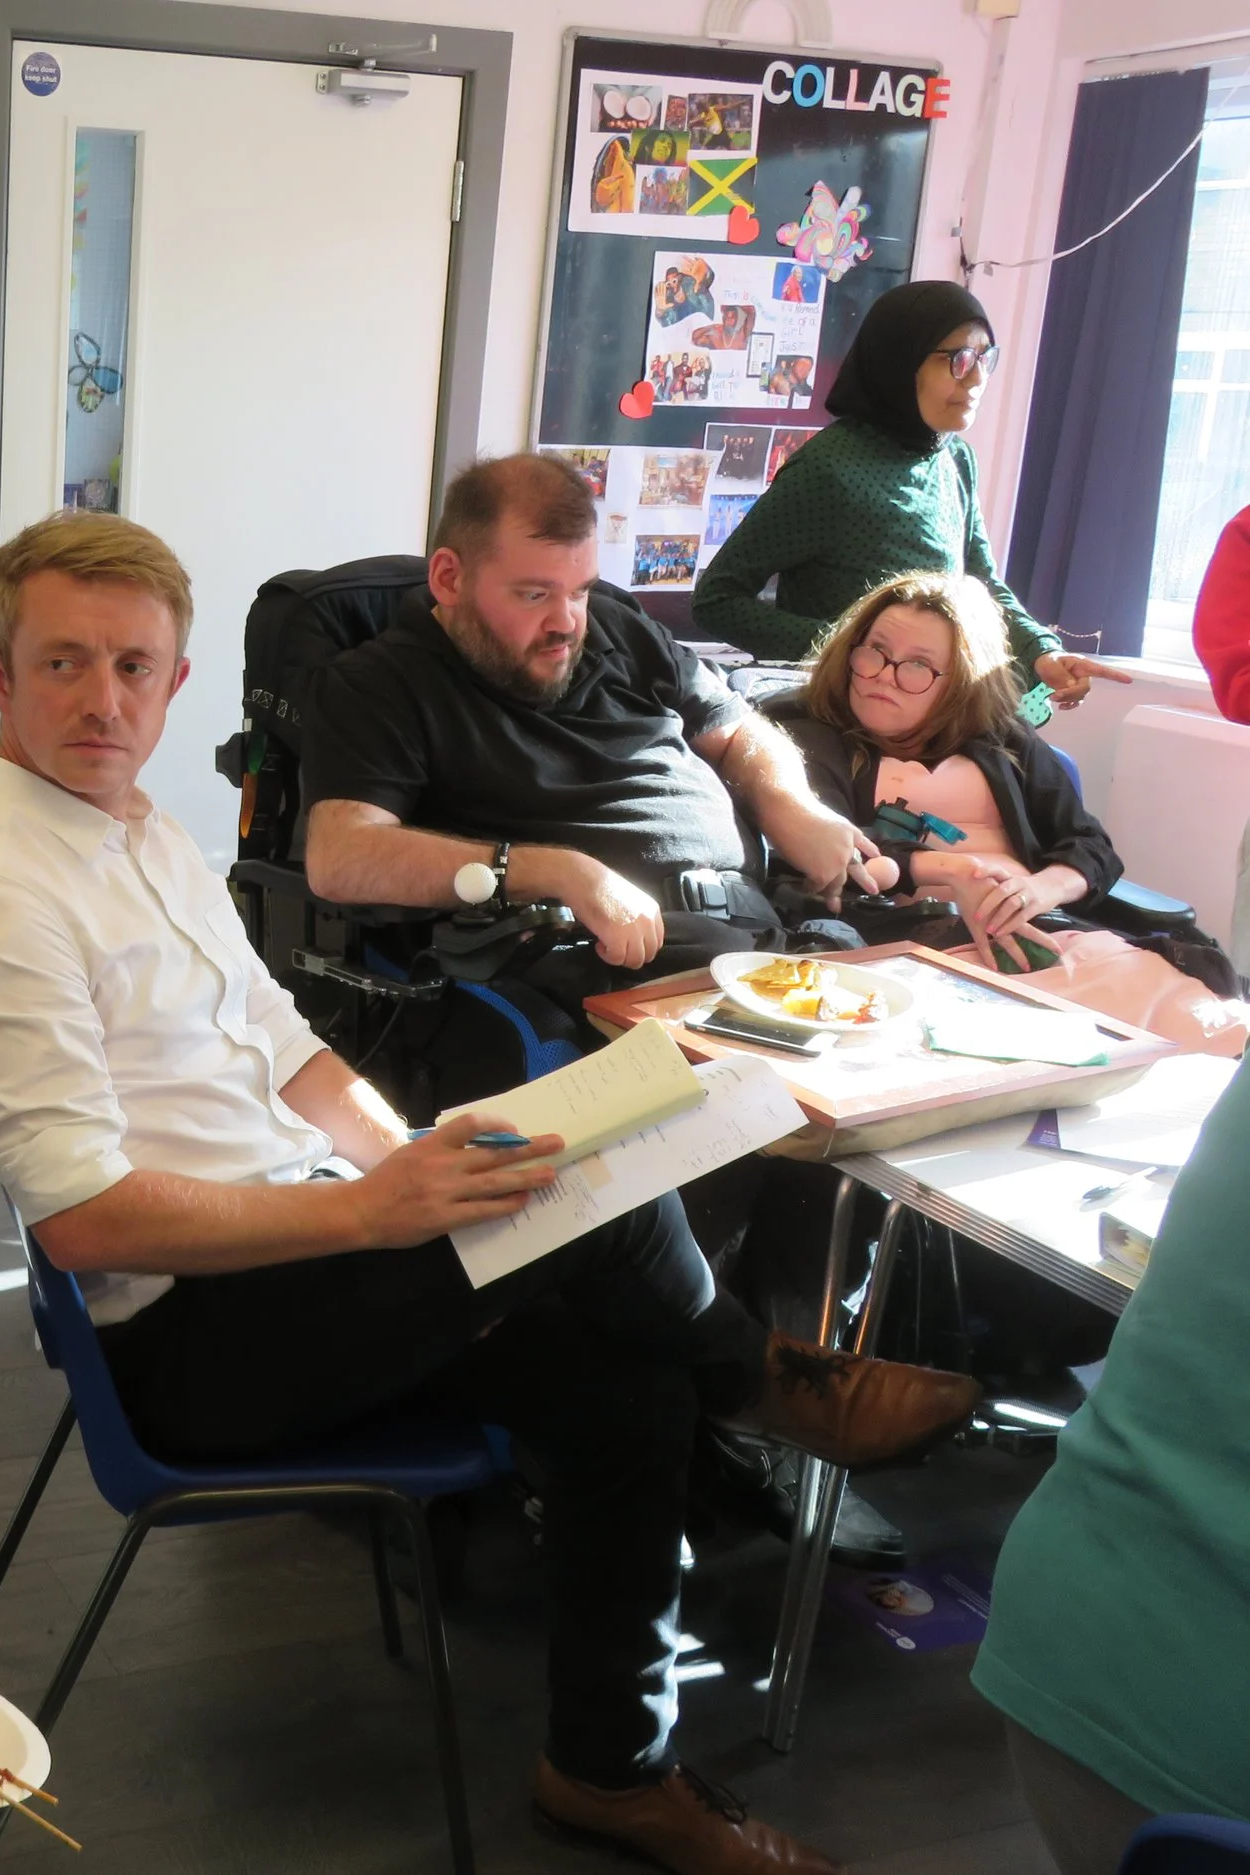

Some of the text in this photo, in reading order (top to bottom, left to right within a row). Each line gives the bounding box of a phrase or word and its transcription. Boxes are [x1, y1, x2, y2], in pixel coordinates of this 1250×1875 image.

[25, 64, 56, 74] Fire door
[24, 74, 58, 83] keep shut
[762, 60, 950, 118] COLLAGE
